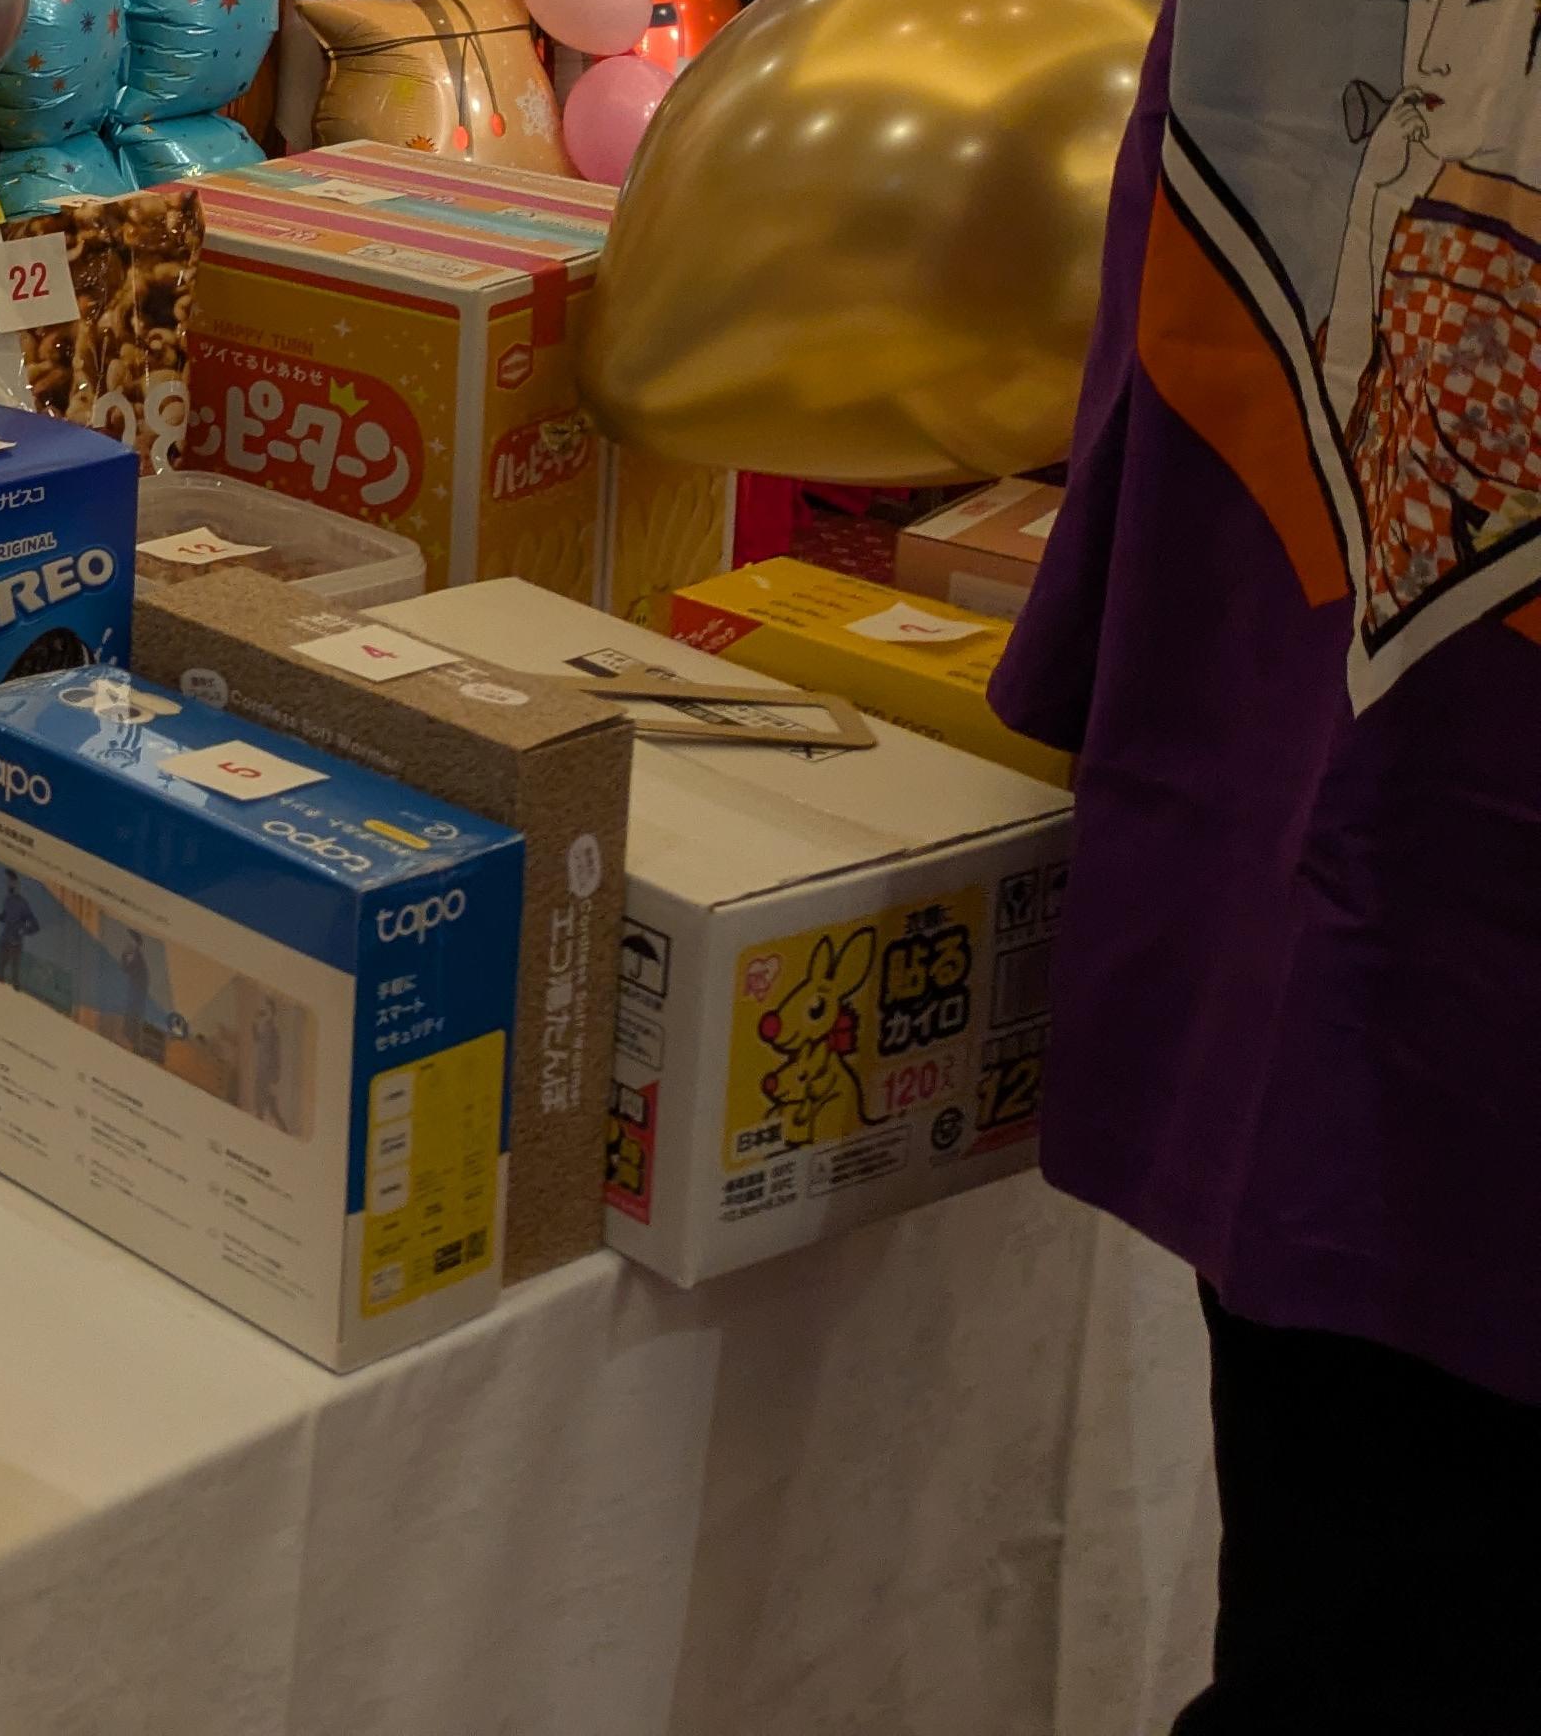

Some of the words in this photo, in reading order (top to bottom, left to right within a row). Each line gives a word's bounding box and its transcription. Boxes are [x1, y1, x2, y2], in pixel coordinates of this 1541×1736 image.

[9, 262, 50, 302] 22
[213, 319, 263, 346] HAPPY
[271, 331, 315, 357] TURN
[199, 341, 325, 387] ツイてるしあわせ
[218, 760, 262, 780] 5
[264, 817, 372, 874] tapo
[376, 888, 467, 944] tapo
[886, 936, 968, 1001] 貼る
[376, 995, 428, 1028] スマート
[884, 995, 965, 1048] カイロ
[374, 1017, 446, 1052] セキュリティ
